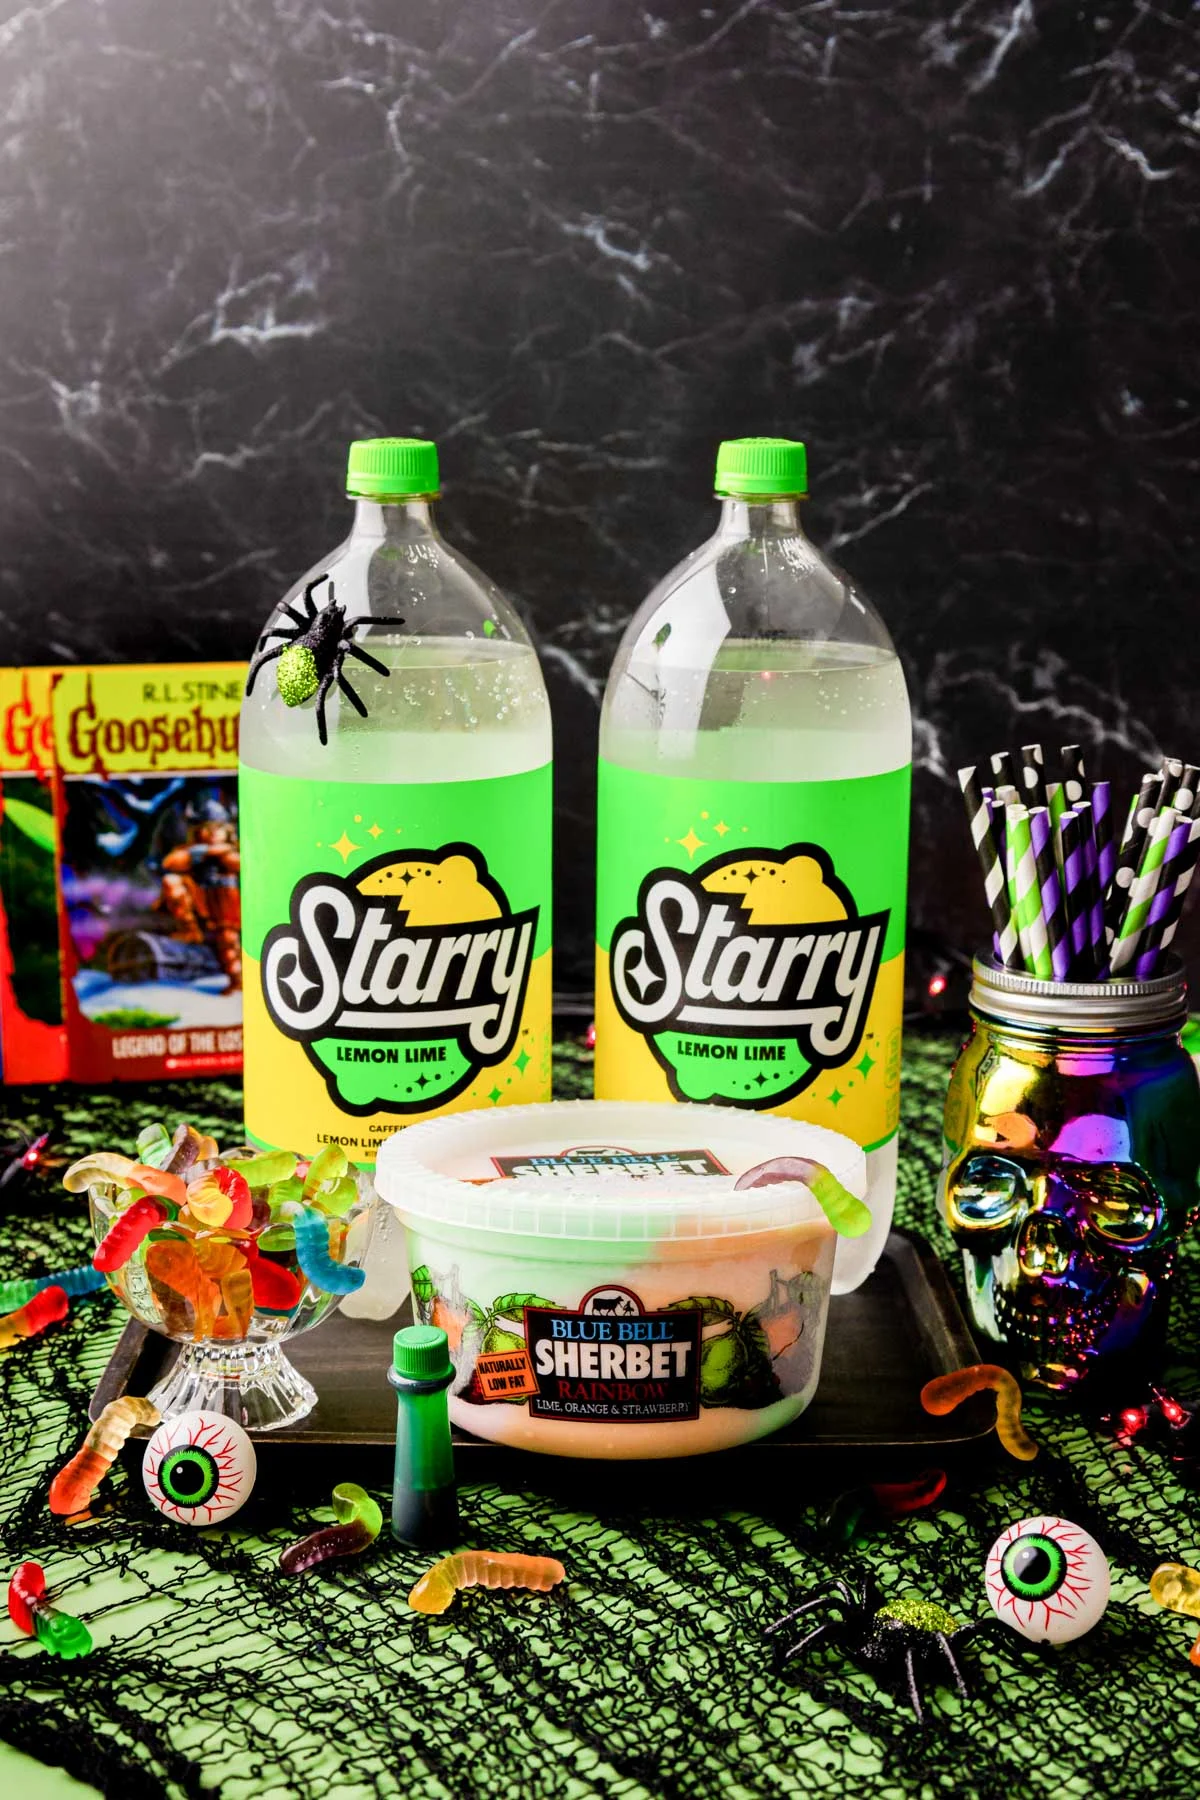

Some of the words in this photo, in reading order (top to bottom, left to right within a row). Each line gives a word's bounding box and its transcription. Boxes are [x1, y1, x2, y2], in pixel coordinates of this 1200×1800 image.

[181, 681, 243, 702] STINE
[266, 884, 533, 1055] Starry
[613, 879, 882, 1057] Starry
[112, 1034, 167, 1059] LEGEND
[168, 1033, 187, 1055] OF
[190, 1032, 216, 1054] THE
[336, 1046, 400, 1064] LEMON
[405, 1046, 447, 1064] LIME
[677, 1040, 738, 1061] LEMON
[744, 1045, 786, 1061] LIME
[316, 1133, 358, 1147] LEMON
[361, 1138, 387, 1148] LIM
[528, 1156, 606, 1166] BLUE
[610, 1153, 679, 1164] BELL
[551, 1319, 613, 1340] BLUE
[618, 1322, 674, 1341] BELL
[477, 1357, 527, 1375] NATURALLY
[535, 1339, 692, 1380] SHERBET
[487, 1377, 507, 1391] LOW
[508, 1375, 526, 1389] FAT
[558, 1380, 668, 1401] RAINBOW
[536, 1399, 563, 1412] LIME,
[564, 1402, 609, 1415] ORANGE
[610, 1403, 620, 1415] &
[622, 1402, 690, 1415] STRAWBERRY
